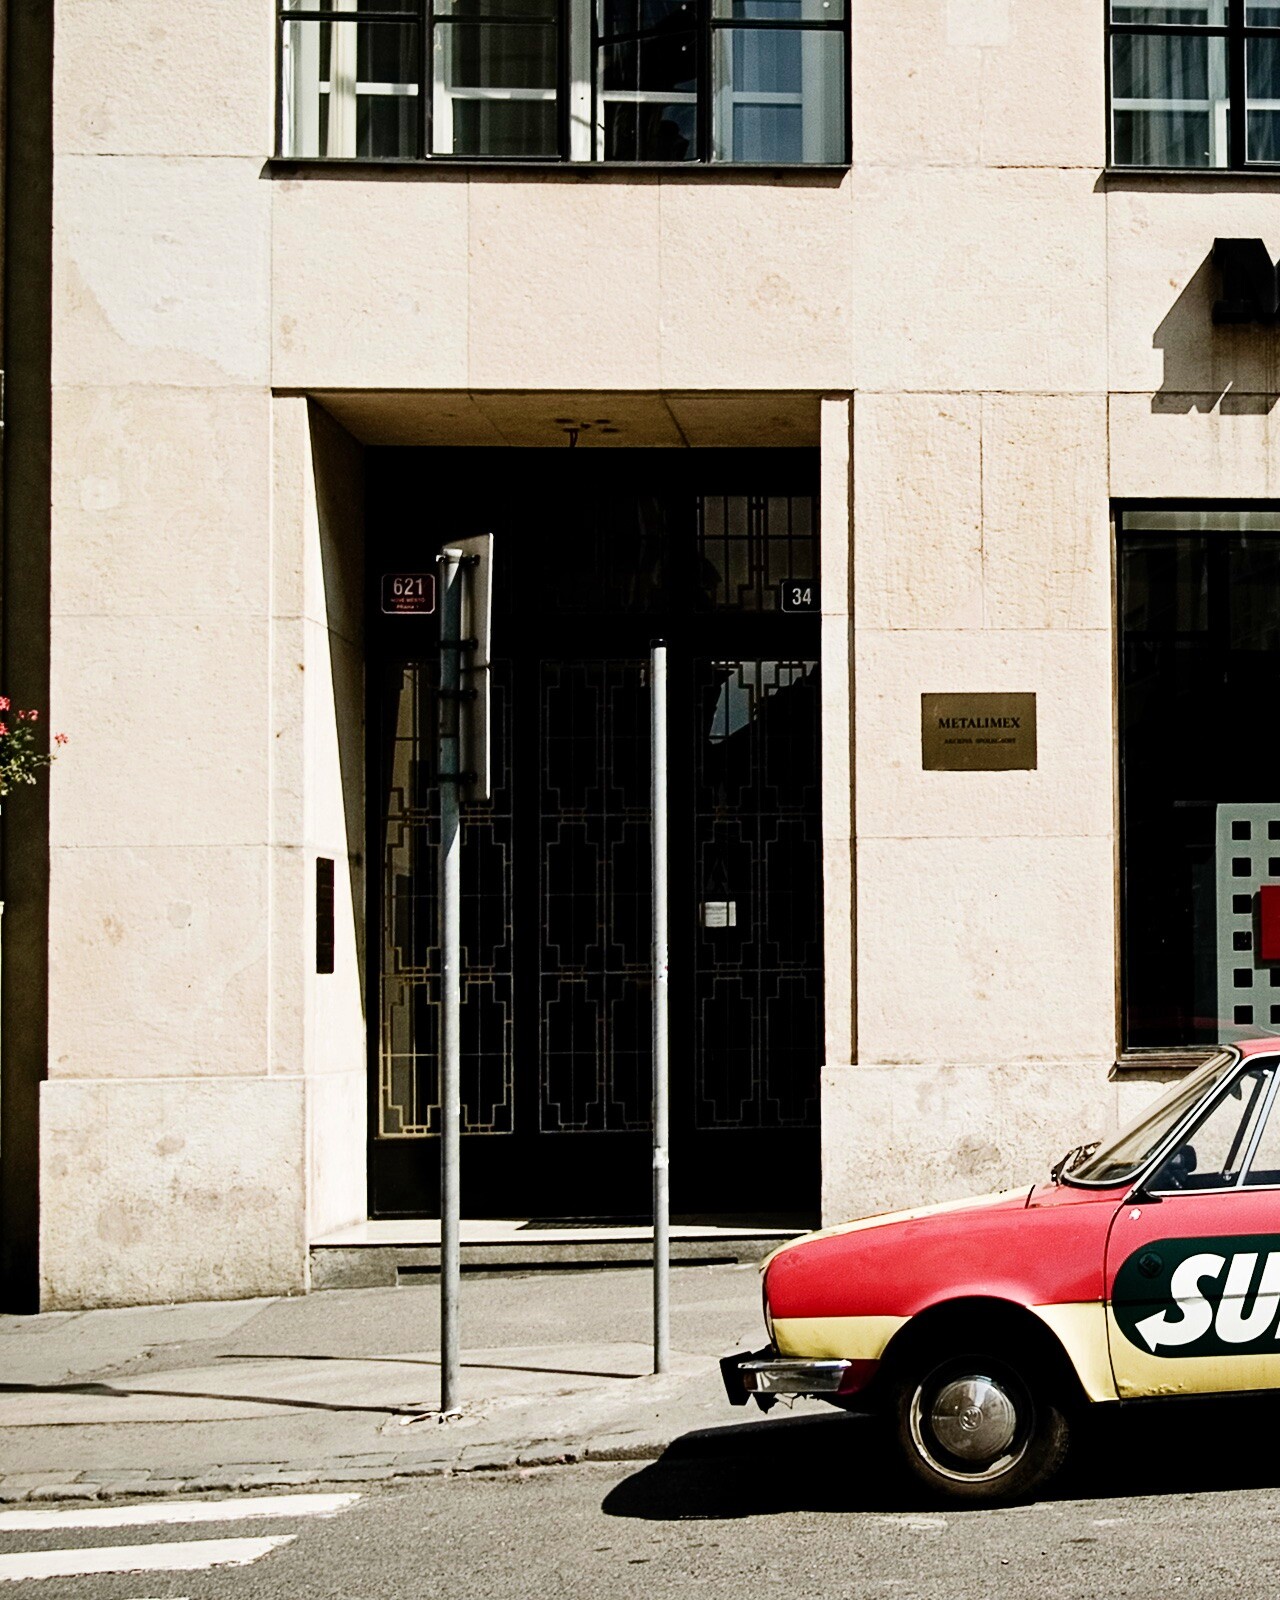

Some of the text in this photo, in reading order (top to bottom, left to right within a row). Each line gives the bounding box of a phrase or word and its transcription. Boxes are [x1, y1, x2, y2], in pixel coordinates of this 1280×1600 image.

[393, 577, 423, 595] 621
[792, 588, 811, 605] 34
[938, 717, 1021, 729] METALIMEX
